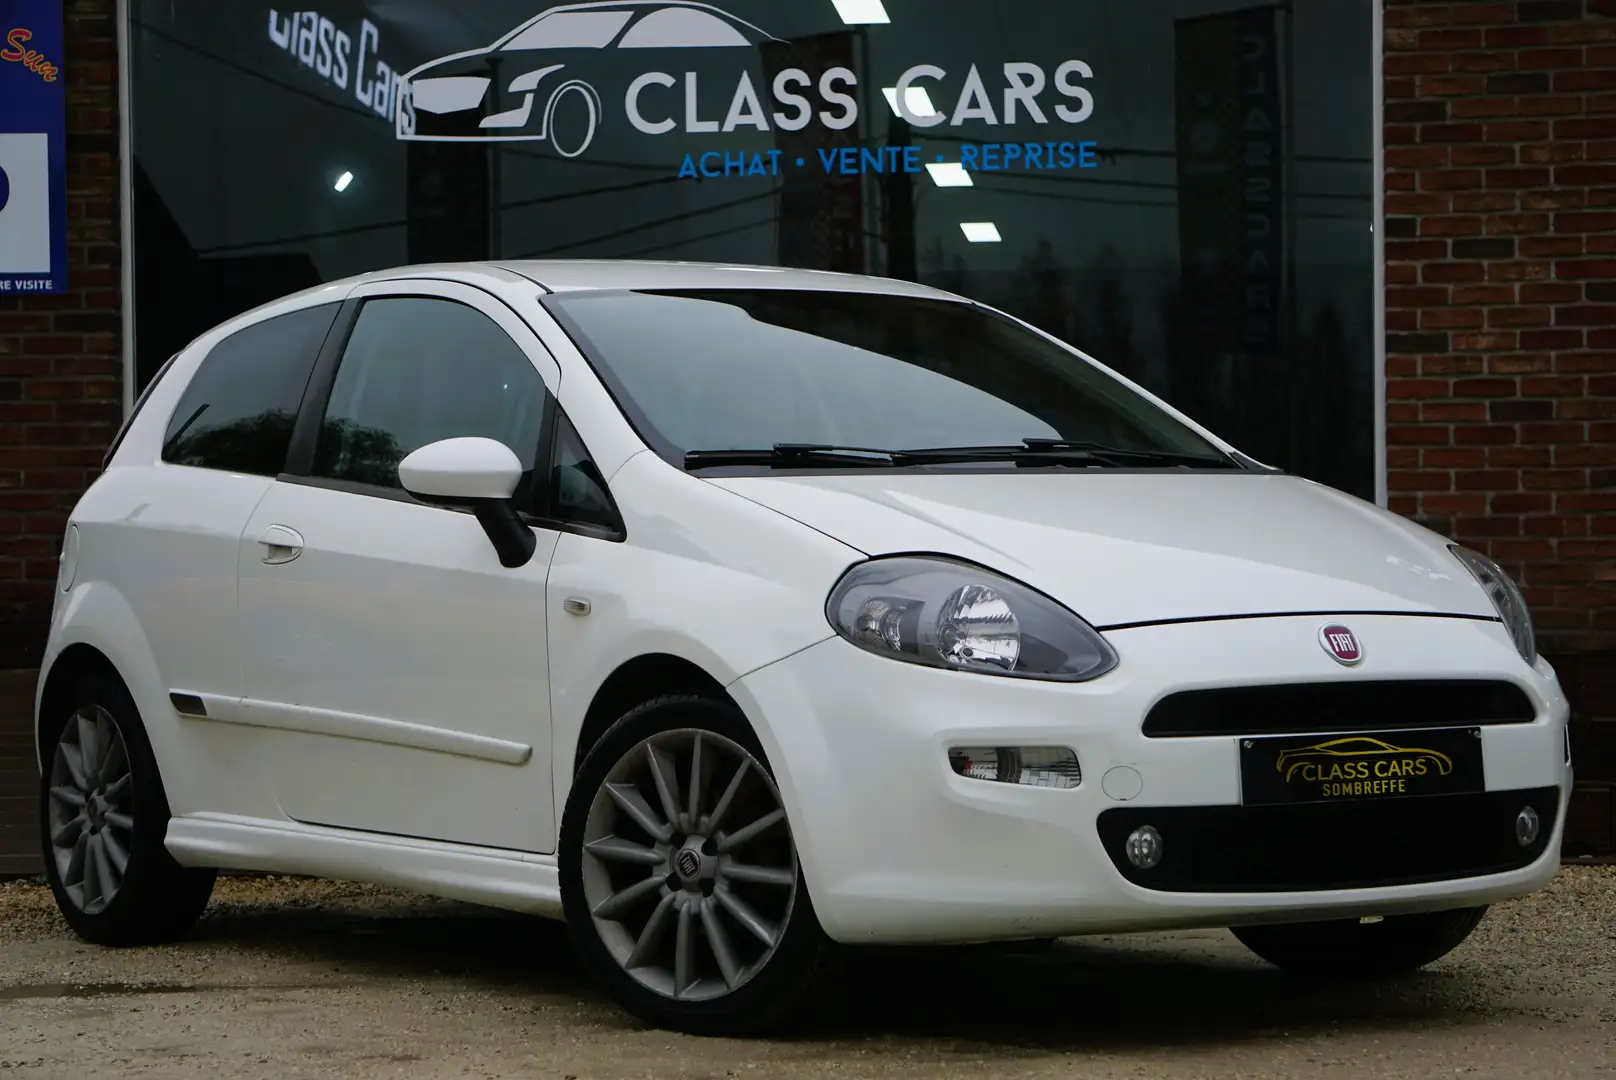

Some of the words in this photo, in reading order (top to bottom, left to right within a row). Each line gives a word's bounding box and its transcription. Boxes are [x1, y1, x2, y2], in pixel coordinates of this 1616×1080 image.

[625, 66, 859, 135] CLASS
[895, 59, 1095, 128] CARS
[678, 149, 783, 179] ACHAT
[817, 144, 922, 176] VENTE
[960, 141, 1098, 171] REPRISE
[15, 279, 53, 290] VISITE
[1329, 633, 1356, 652] FIAT
[1302, 762, 1369, 781] CLASS
[1374, 758, 1427, 778] CARS
[1322, 779, 1406, 797] SOMBREFFE
